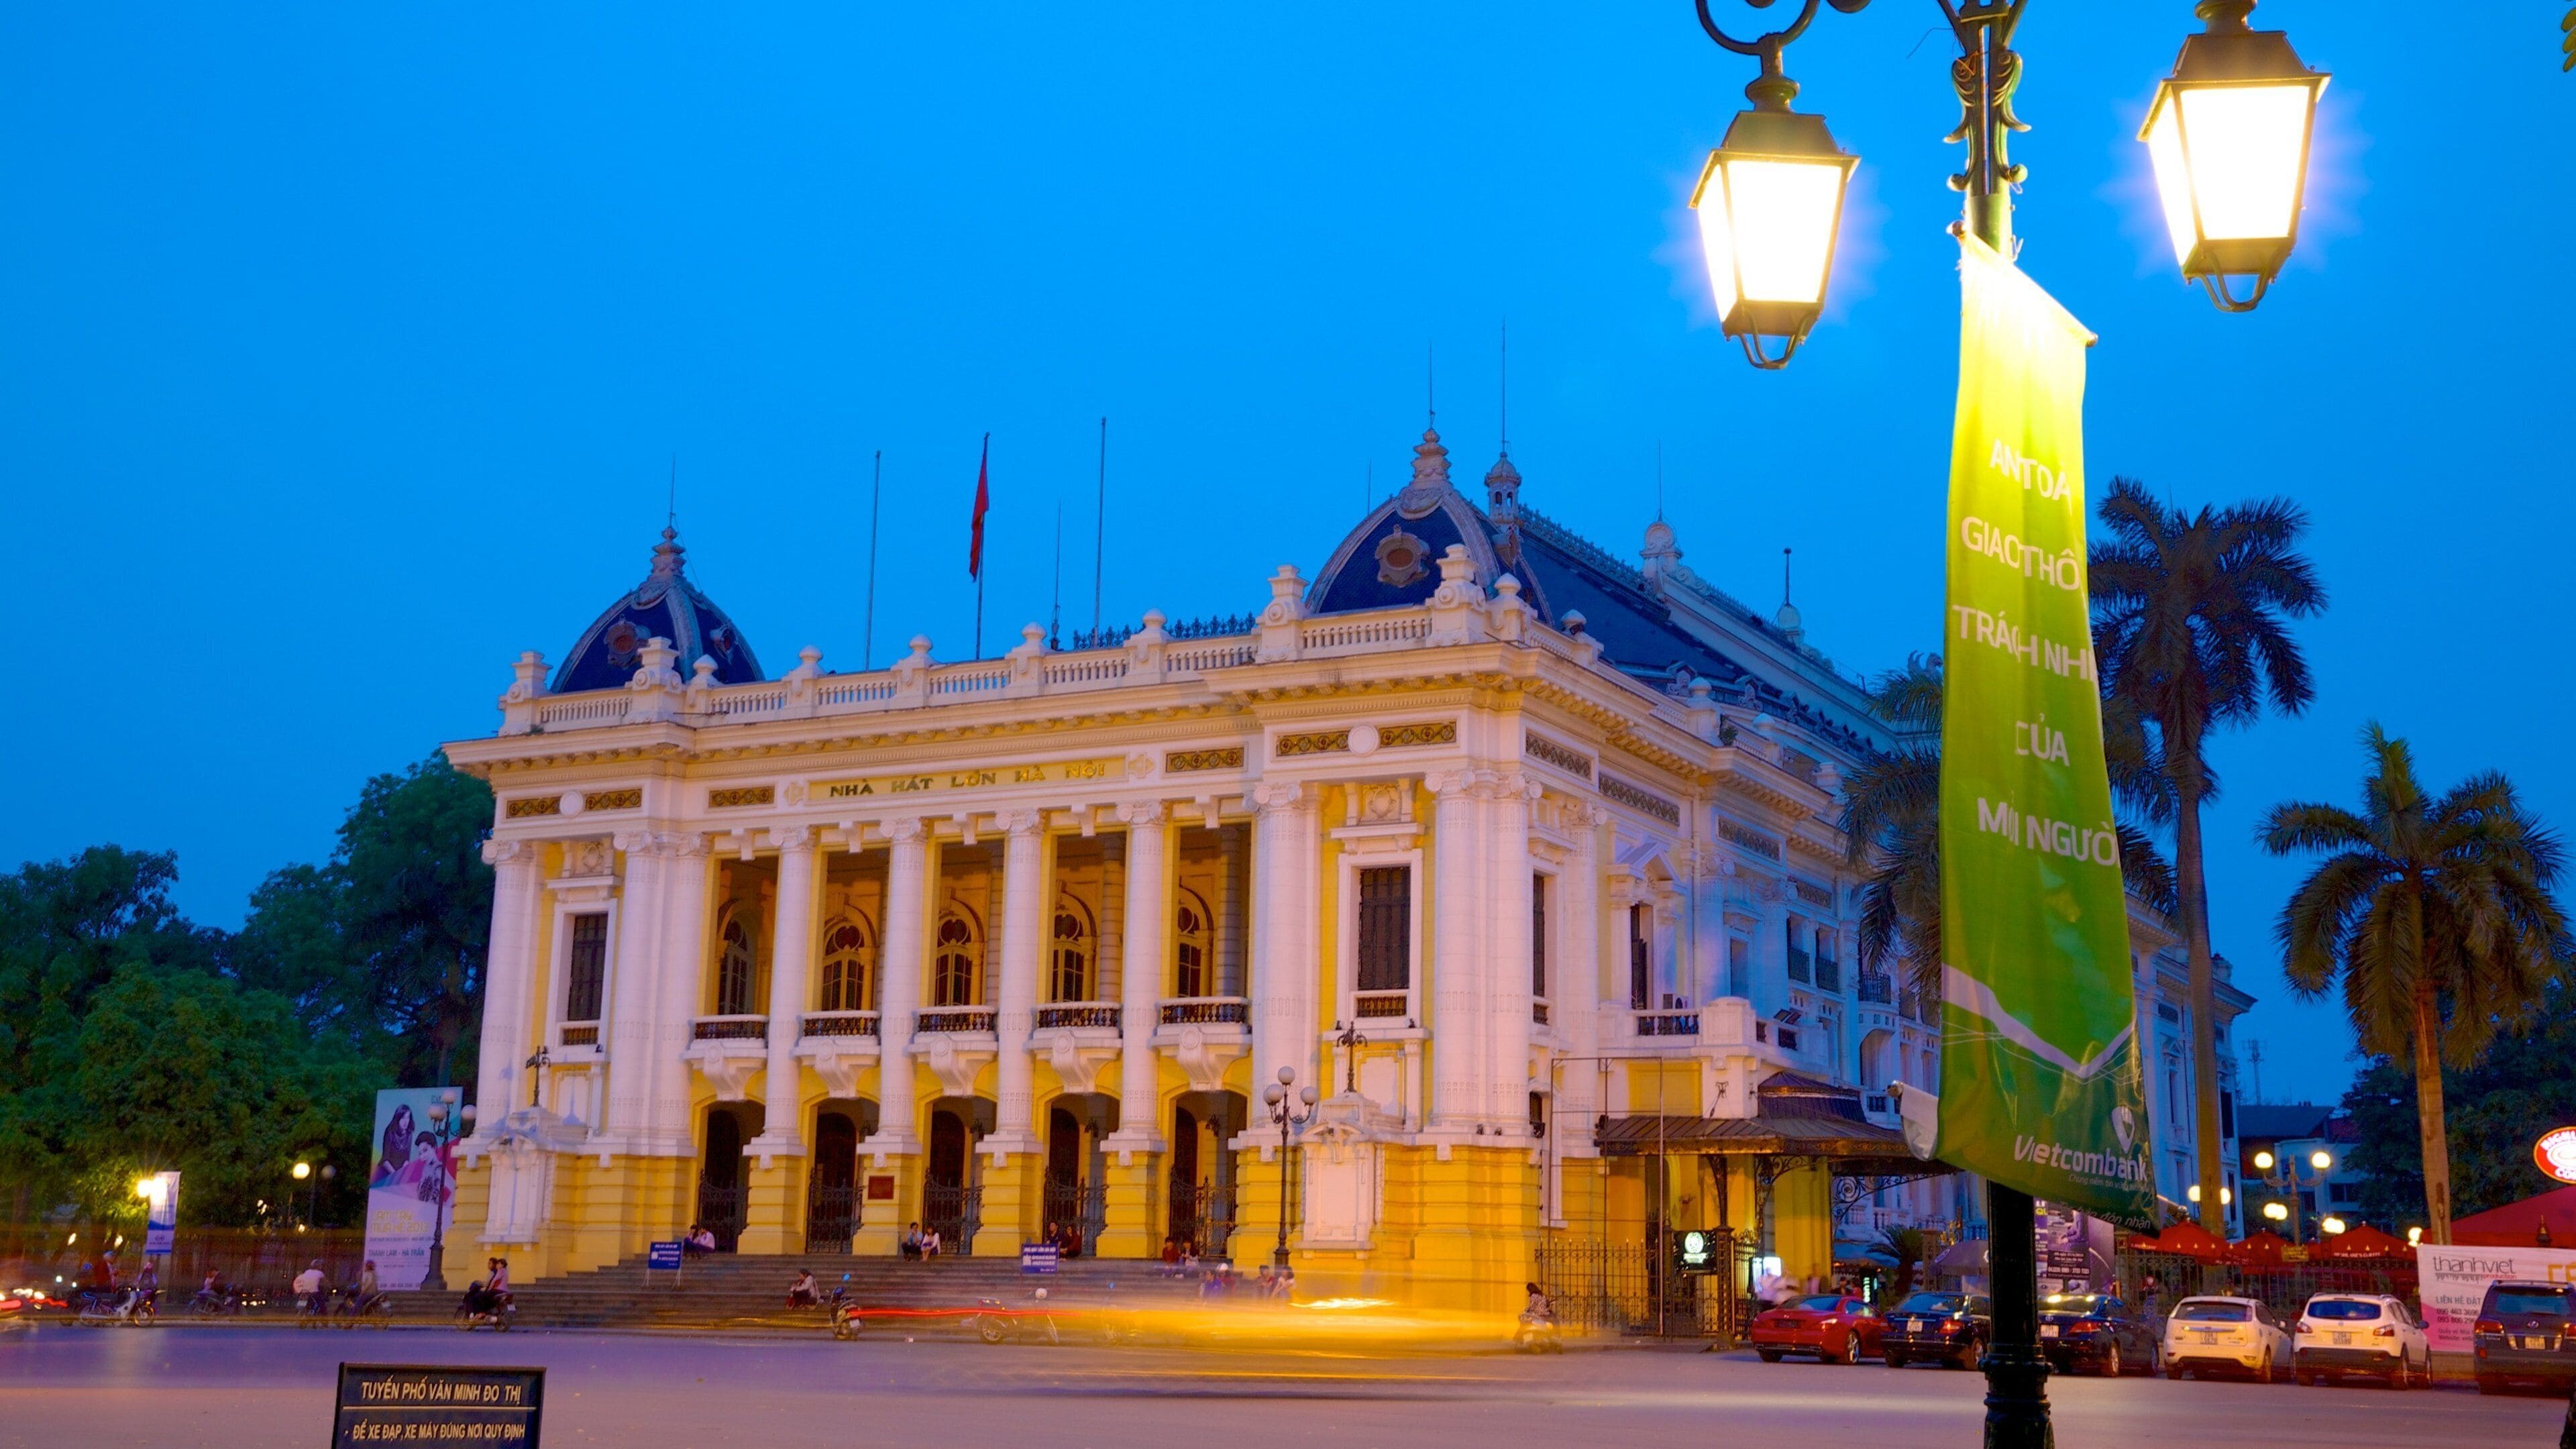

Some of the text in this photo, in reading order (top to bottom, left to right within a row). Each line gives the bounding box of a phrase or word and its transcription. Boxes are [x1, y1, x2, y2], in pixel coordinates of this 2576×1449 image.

[2019, 545, 2080, 590] THÔ
[2045, 639, 2098, 682] NHI
[830, 760, 1106, 797] NHÀ HÁT LỚN HÀ NỘI
[2026, 815, 2117, 866] NGƯỜ
[2014, 1134, 2147, 1181] Vietcombank
[2436, 1295, 2453, 1304] LIÊN
[361, 1375, 400, 1399] TUYẾN
[402, 1377, 428, 1399] PHỐ
[429, 1379, 452, 1399] VĂN
[454, 1384, 481, 1401] MINH
[504, 1385, 522, 1406] THỊ
[353, 1418, 368, 1440] ĐỂ
[368, 1424, 381, 1439] XE
[404, 1424, 417, 1439] XE
[419, 1421, 438, 1439] MÁY
[439, 1421, 466, 1439] ĐÚNG
[468, 1424, 483, 1438] NƠI
[484, 1424, 503, 1438] QUY
[504, 1424, 526, 1441] ĐỊNH
